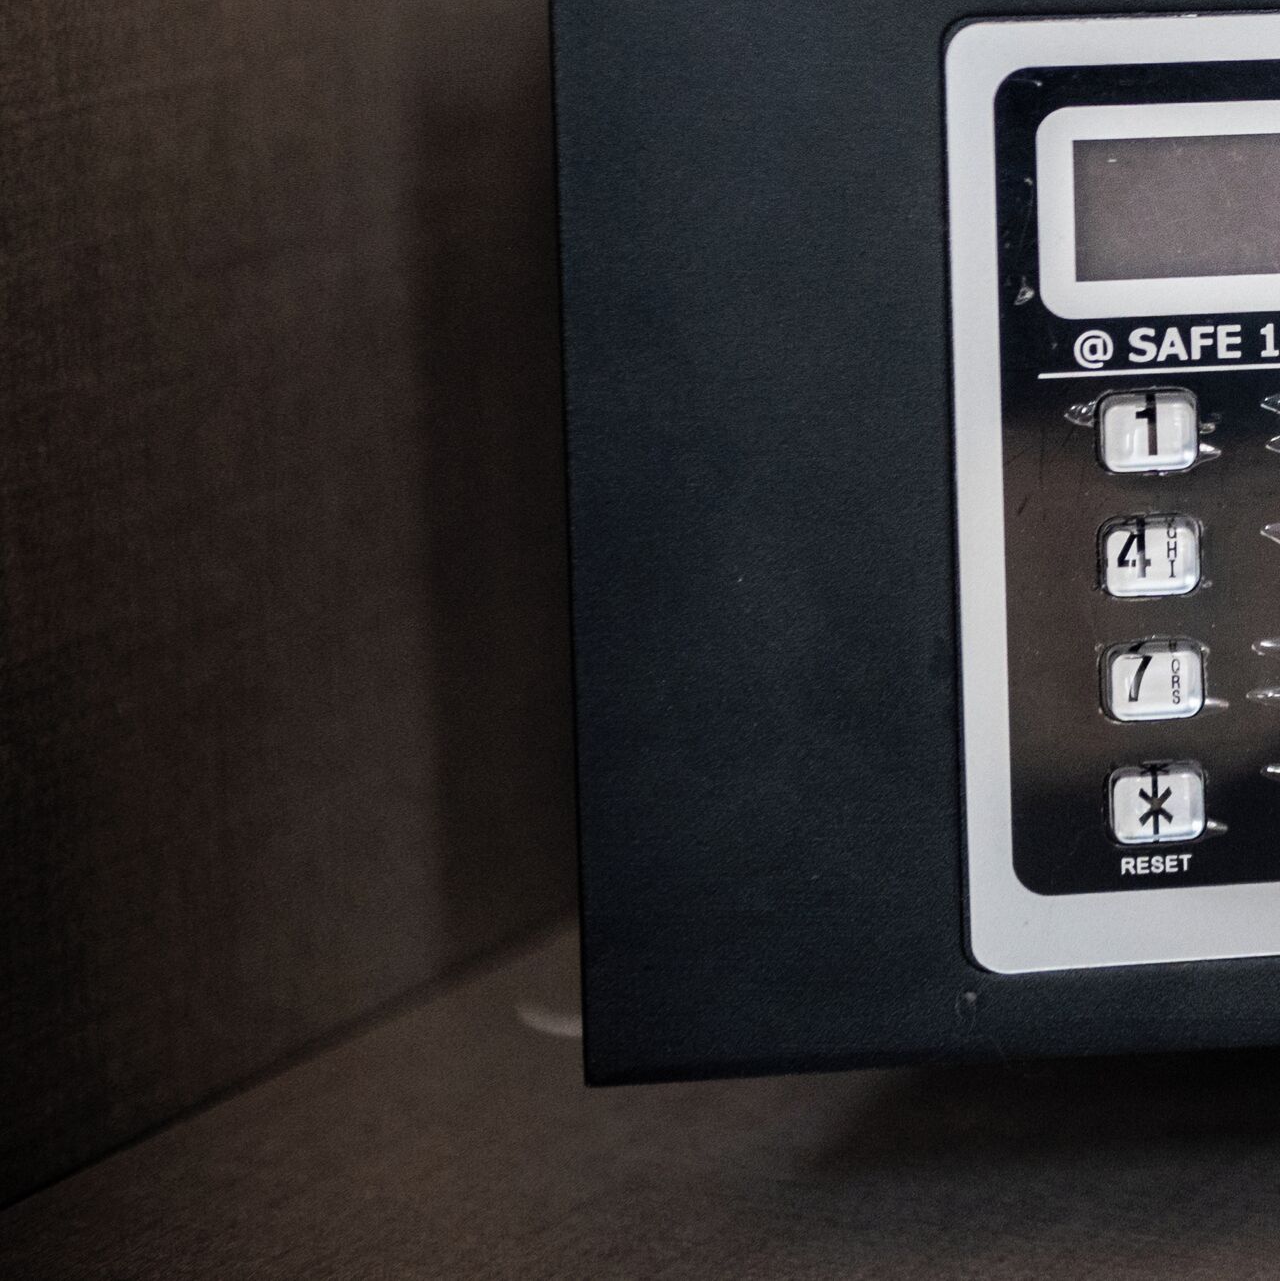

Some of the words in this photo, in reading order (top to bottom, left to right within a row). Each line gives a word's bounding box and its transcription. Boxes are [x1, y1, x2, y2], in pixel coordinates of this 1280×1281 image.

[1128, 324, 1242, 363] SAFE
[1134, 391, 1159, 456] 1
[1125, 653, 1153, 703] 7
[1119, 853, 1194, 876] RESET
